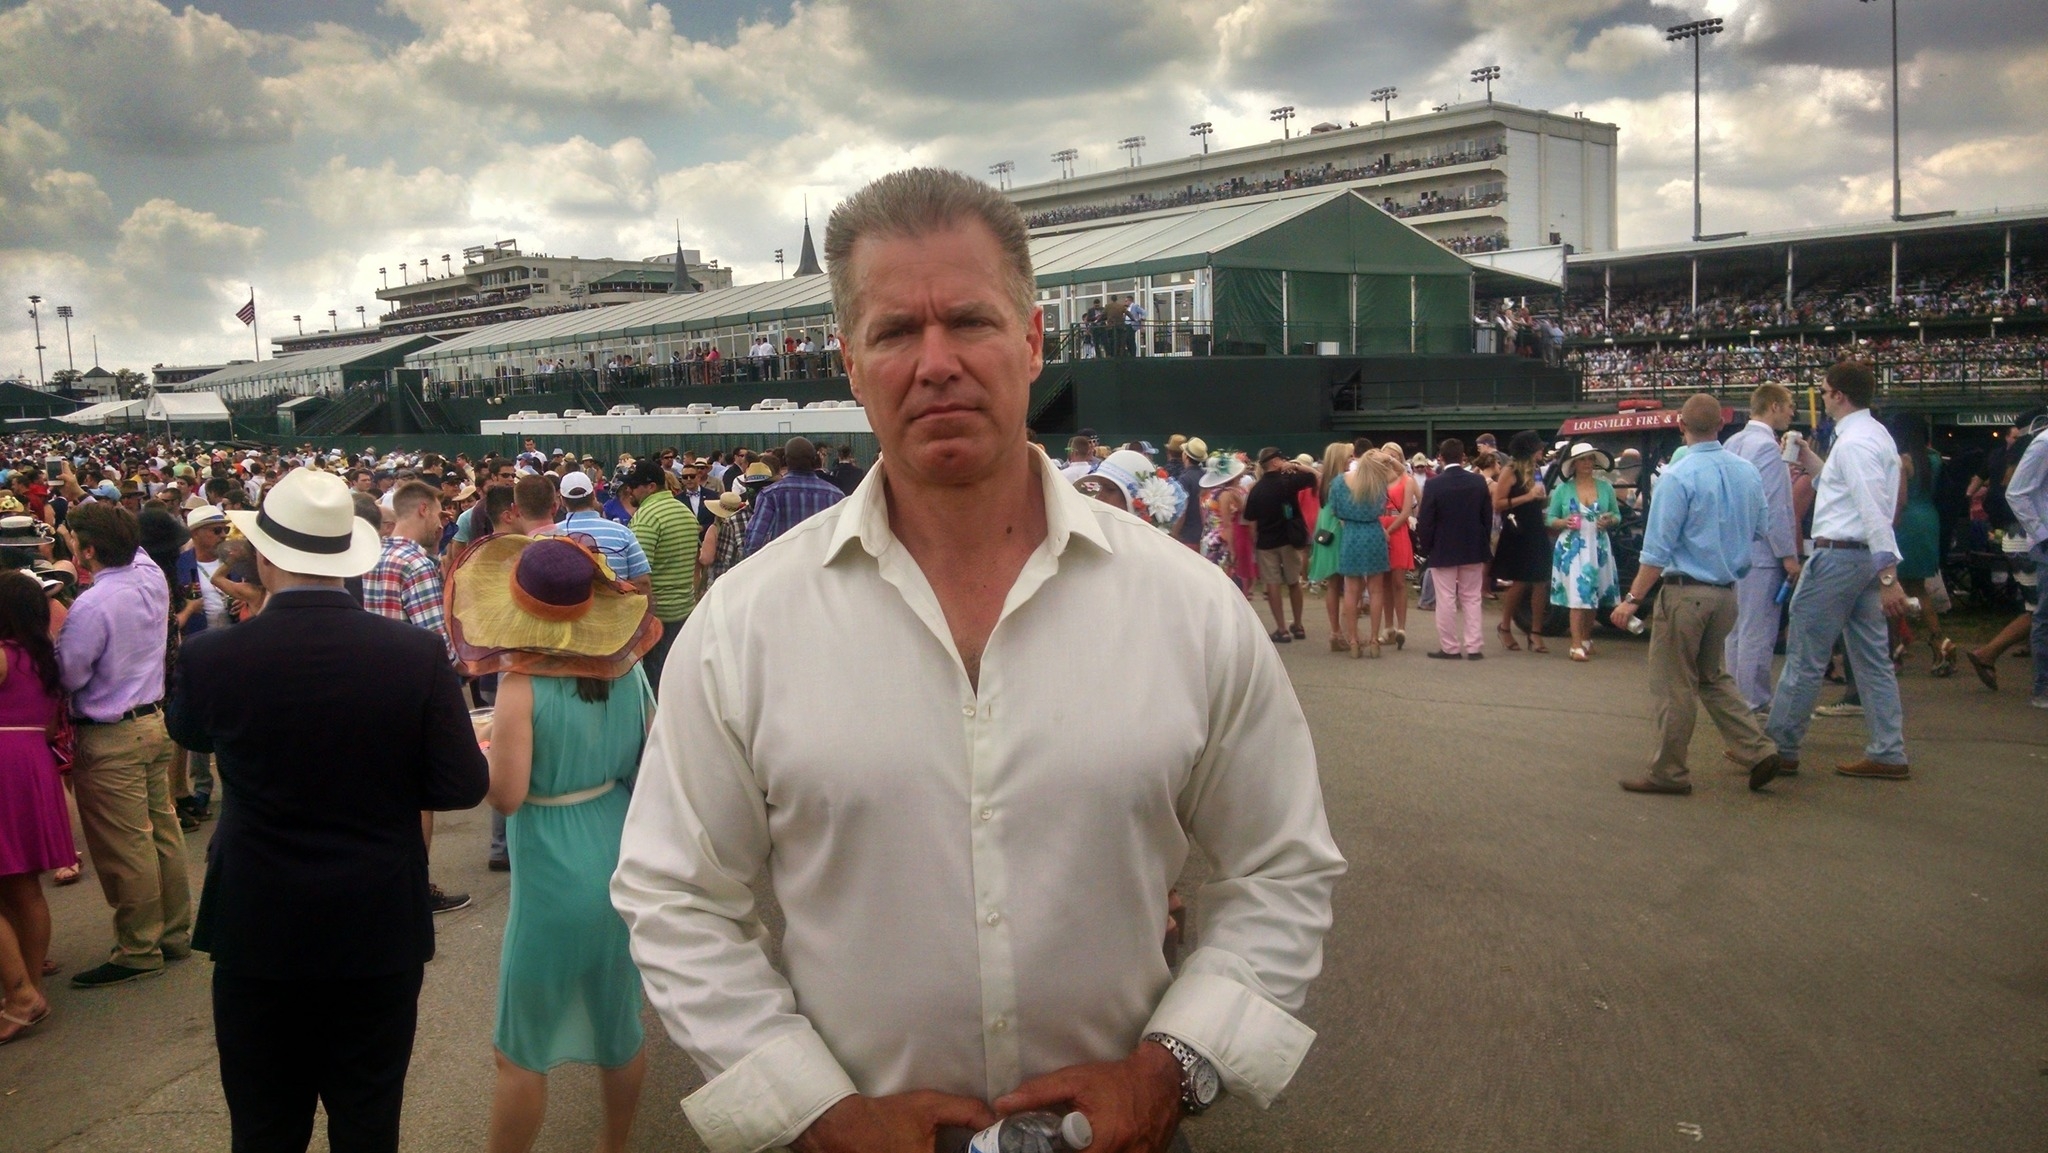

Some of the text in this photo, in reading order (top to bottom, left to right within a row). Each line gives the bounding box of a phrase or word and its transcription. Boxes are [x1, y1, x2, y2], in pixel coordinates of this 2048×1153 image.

[1574, 417, 1633, 431] LOUISVILLE
[1636, 415, 1660, 426] FIRE
[1663, 415, 1672, 424] &
[1972, 414, 1988, 423] ALL
